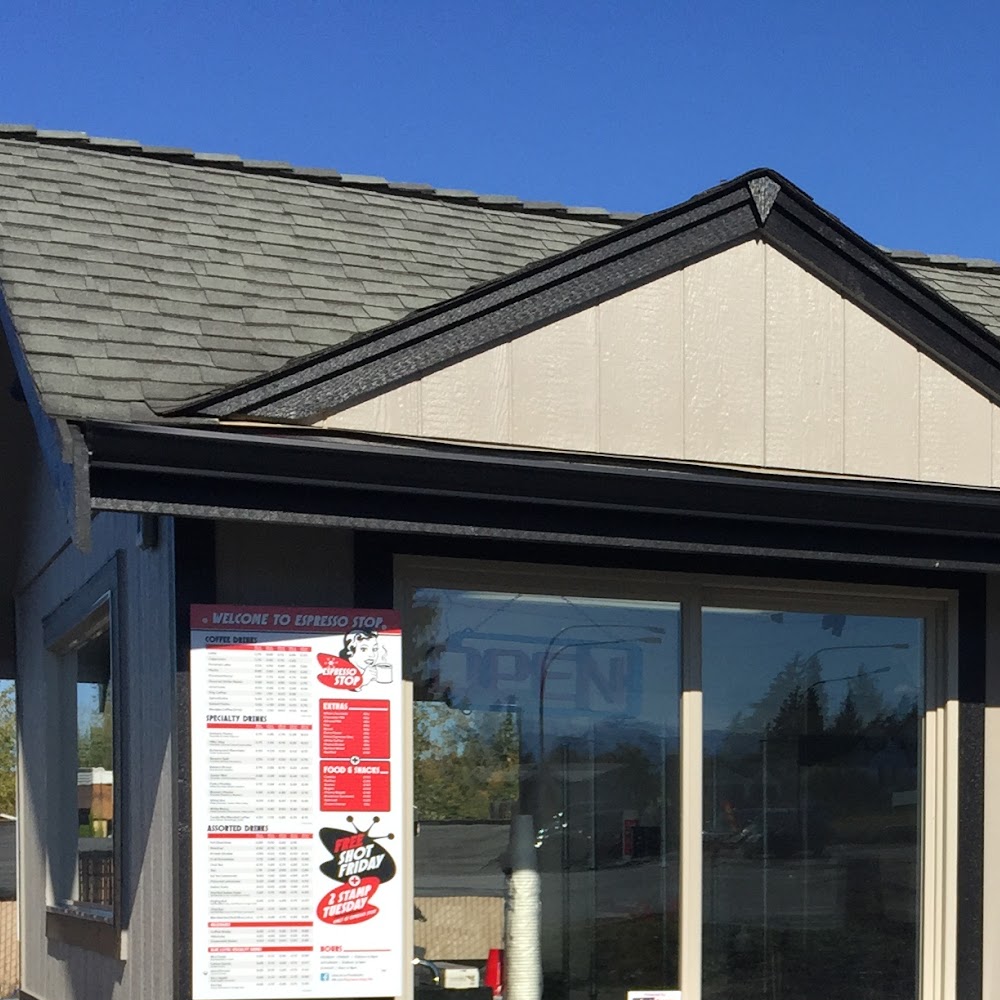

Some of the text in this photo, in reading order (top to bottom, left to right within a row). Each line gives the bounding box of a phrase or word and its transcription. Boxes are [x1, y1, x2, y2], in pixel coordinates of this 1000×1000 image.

[212, 612, 384, 629] WELCOME TO ESPRESSO STOP
[205, 635, 231, 643] COFFEE
[322, 667, 357, 676] ESPRESSO
[334, 676, 361, 686] STOP
[323, 702, 349, 711] EXTRAS
[243, 715, 267, 723] DRINKS
[323, 766, 346, 774] FOOD
[353, 766, 380, 774] SNACKS
[334, 833, 365, 853] FREE
[338, 844, 375, 865] SHOT
[338, 853, 385, 878] FRIDAY
[328, 884, 372, 905] 2 STAMP
[323, 896, 368, 918] TUESDAY
